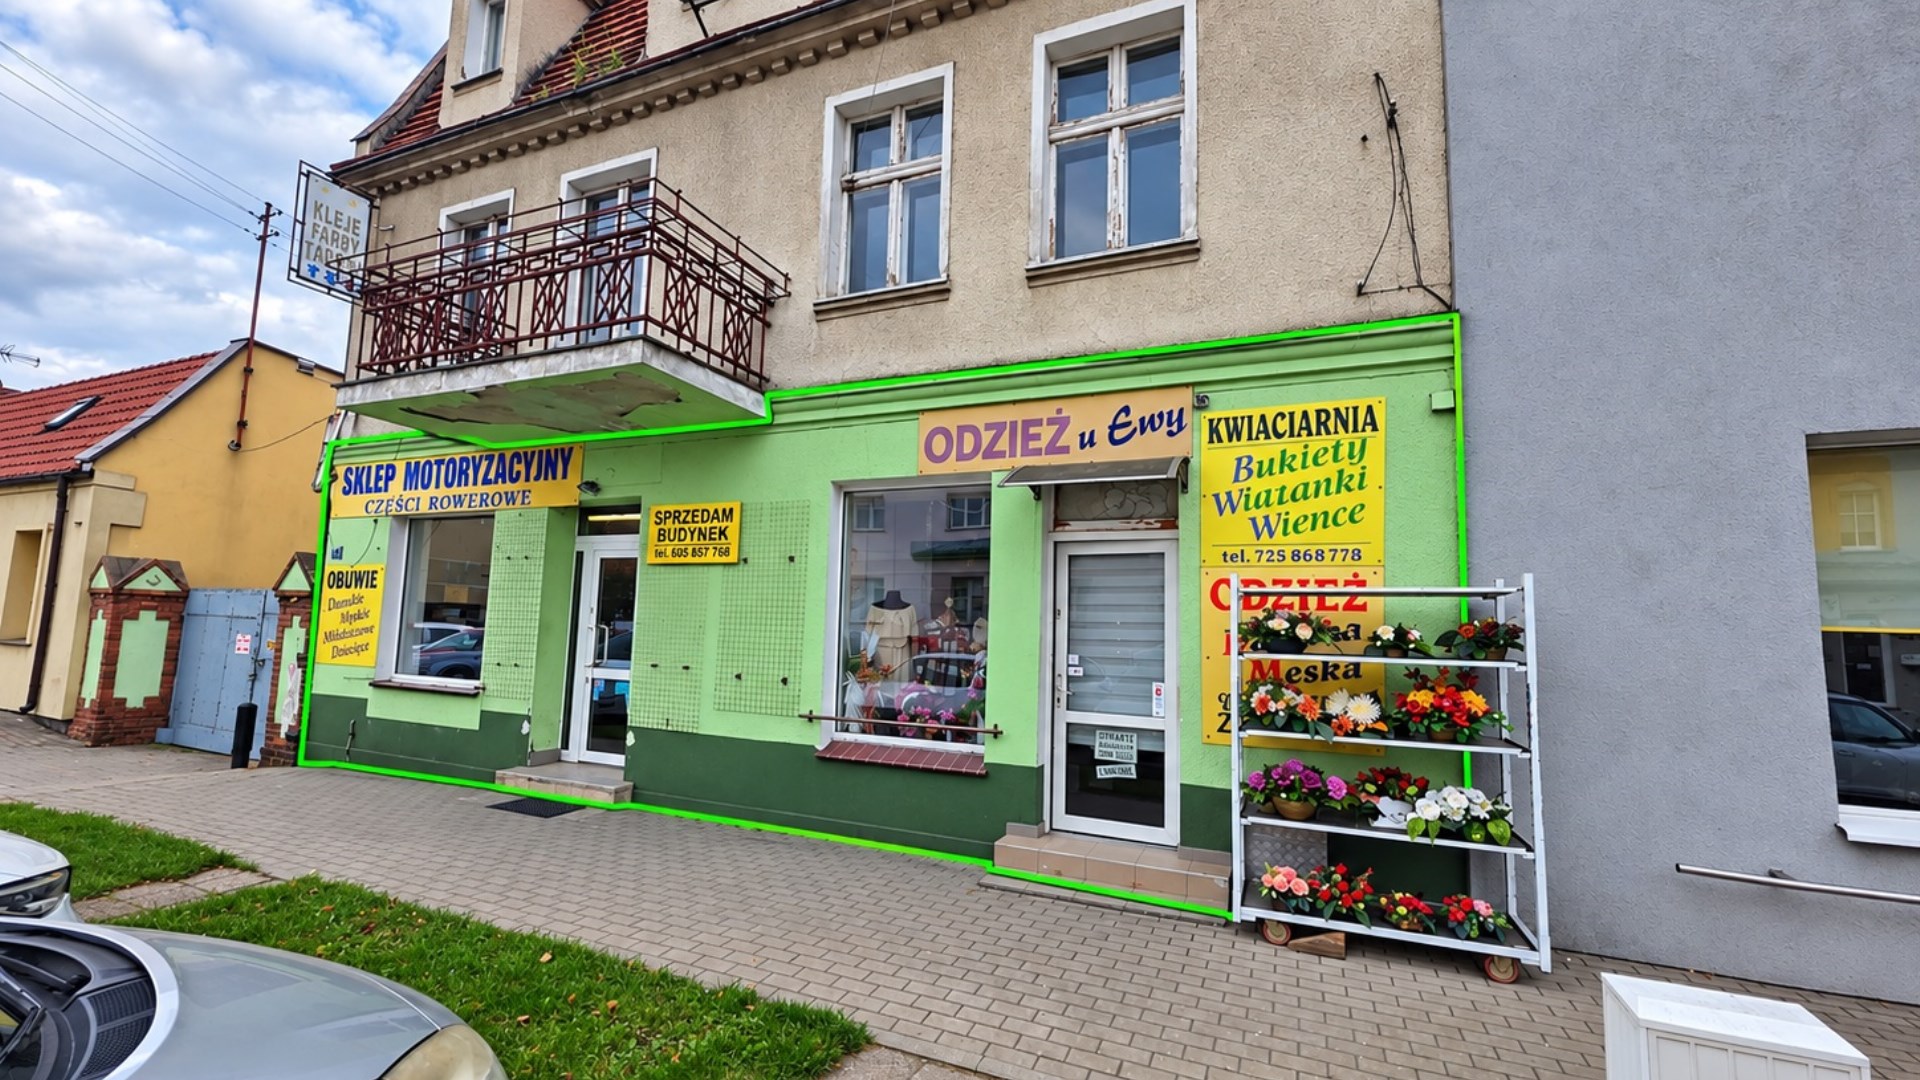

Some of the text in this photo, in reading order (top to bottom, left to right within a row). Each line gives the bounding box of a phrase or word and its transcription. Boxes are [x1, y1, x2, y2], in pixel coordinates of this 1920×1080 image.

[313, 200, 361, 236] KLEJE
[312, 222, 360, 254] FARBY
[924, 404, 1188, 464] ODZIEŻ u Ewy
[1207, 404, 1379, 444] KWIACIARNIA
[342, 446, 574, 496] SKLEP MOTORYZACYJNY
[1232, 437, 1368, 484] Bukiety
[364, 489, 531, 516] CZĘŚCI ROWEROWE
[654, 507, 734, 526] SPRZEDAM
[657, 525, 729, 542] BUDYNEK
[1248, 502, 1366, 541] Wience
[671, 547, 689, 558] 605
[1222, 548, 1362, 563] tel. 725 868 778
[327, 569, 378, 589] OBUWIE
[1209, 571, 1368, 612] ODZIEŻ
